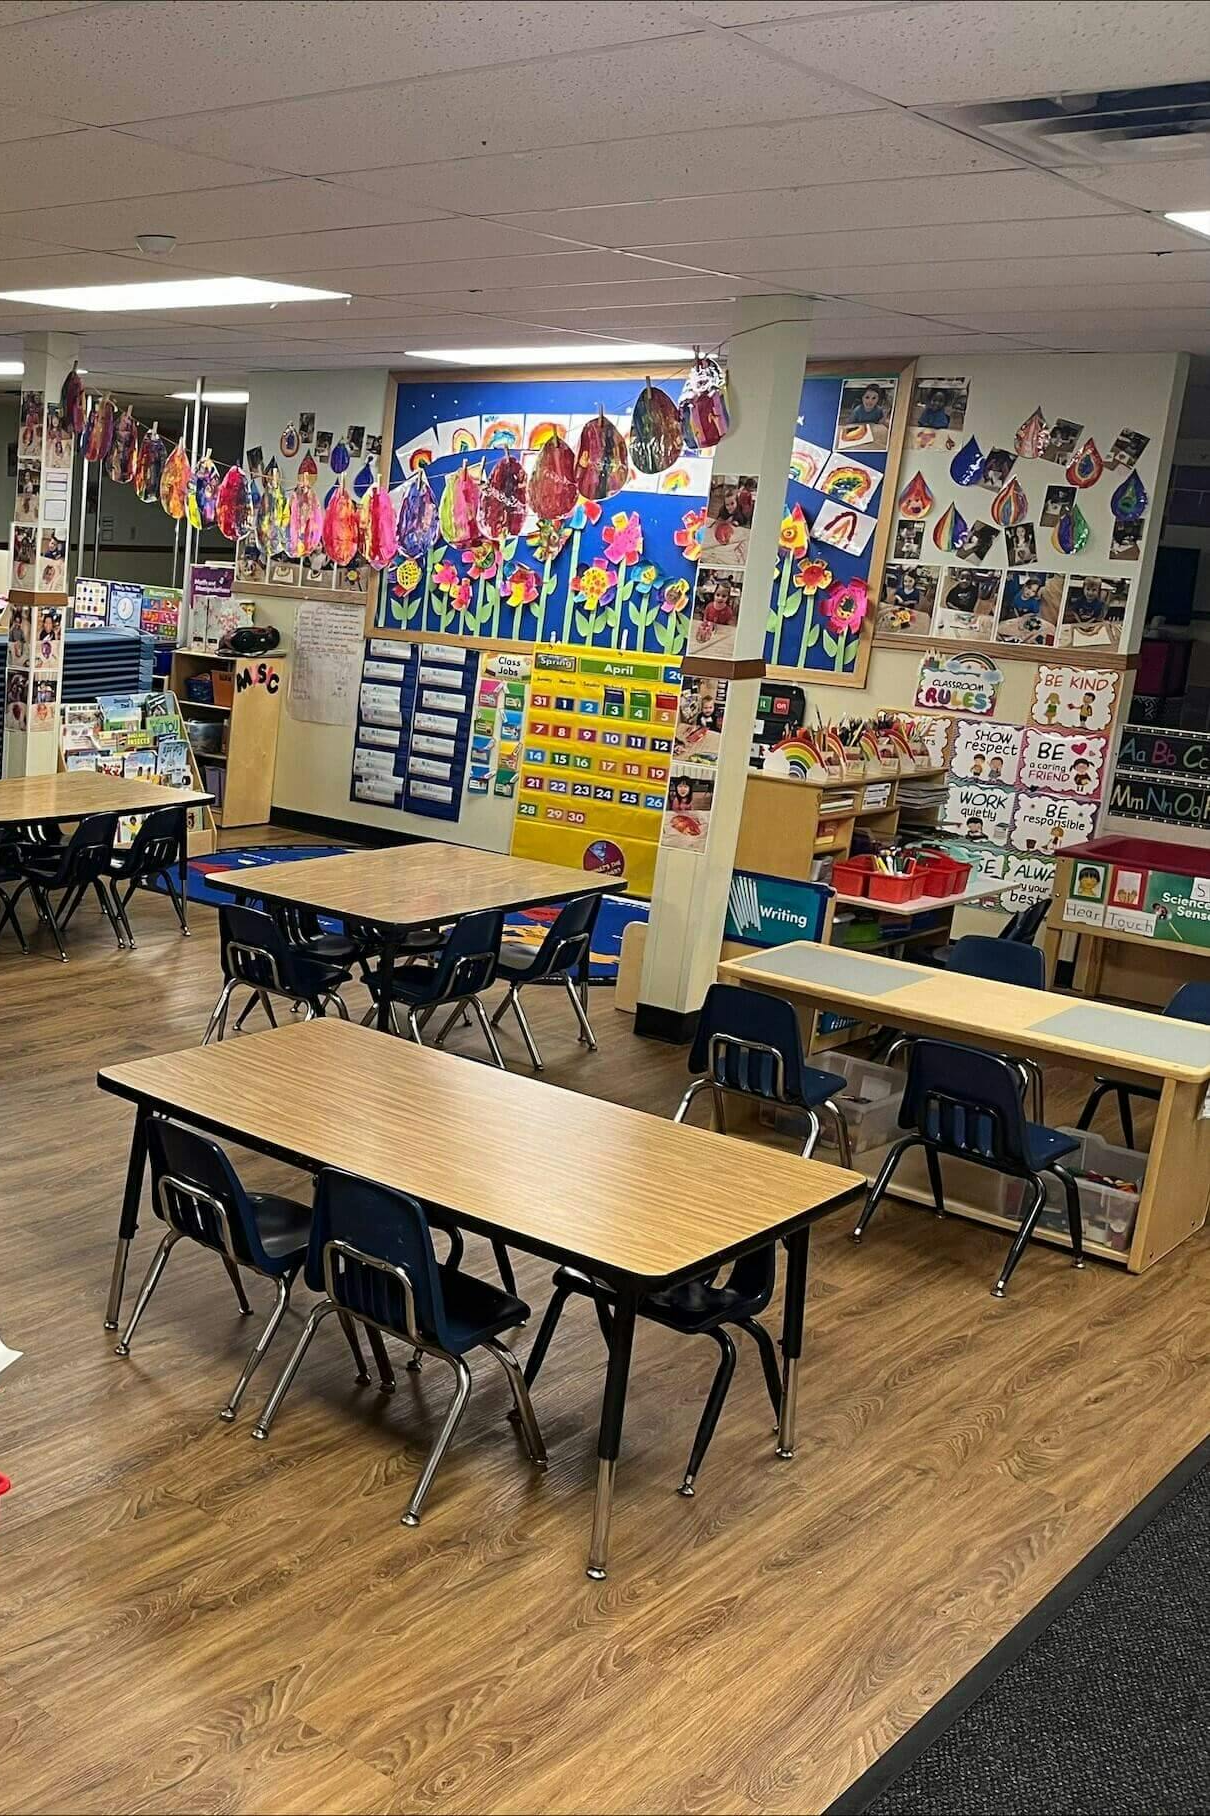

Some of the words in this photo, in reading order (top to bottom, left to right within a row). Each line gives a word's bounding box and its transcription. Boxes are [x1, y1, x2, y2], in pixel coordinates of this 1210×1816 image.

[499, 656, 520, 666] Class
[540, 657, 572, 669] Spring
[498, 667, 518, 676] Jobs
[604, 664, 633, 675] April
[932, 679, 984, 691] CLASSROOM
[1044, 674, 1063, 687] BE
[1069, 677, 1109, 692] KIND
[925, 687, 987, 709] RULES
[534, 696, 546, 706] 31
[562, 700, 567, 708] 1
[585, 703, 594, 711] 2
[611, 706, 619, 715] 3
[634, 710, 643, 718] 4
[661, 712, 669, 721] 5
[534, 725, 544, 733] 7
[558, 728, 566, 736] 8
[583, 731, 591, 739] 9
[605, 734, 619, 743] 10
[630, 737, 642, 747] 11
[655, 741, 669, 751] 12
[975, 729, 1012, 744] SHOW
[964, 739, 1018, 756] respect
[1038, 742, 1065, 760] BE
[1118, 737, 1146, 762] Aa
[1151, 740, 1177, 766] Bb
[1183, 745, 1209, 769] Cc
[529, 752, 542, 760] 14
[554, 755, 567, 764] 15
[576, 757, 588, 767] 16
[601, 761, 615, 771] 17
[626, 765, 639, 774] 18
[651, 769, 664, 778] 19
[1038, 763, 1066, 773] caring
[1029, 769, 1070, 782] FRIEND
[527, 778, 540, 787] 21
[550, 782, 566, 791] 22
[574, 785, 590, 795] 23
[595, 789, 611, 799] 24
[621, 793, 637, 803] 25
[647, 797, 663, 807] 26
[960, 791, 1008, 809] WORK
[1110, 784, 1143, 810] Mm
[1146, 787, 1172, 815] Nn
[1174, 793, 1201, 817] Oo
[520, 805, 535, 814] 28
[547, 809, 562, 818] 29
[568, 812, 584, 822] 30
[960, 807, 997, 821] quietly
[1046, 804, 1070, 819] BE
[1023, 815, 1086, 831] responsible
[1028, 884, 1049, 893] your
[1010, 889, 1042, 905] best
[760, 904, 807, 928] Writing
[1066, 905, 1099, 920] Hear
[1110, 913, 1152, 932] Touch
